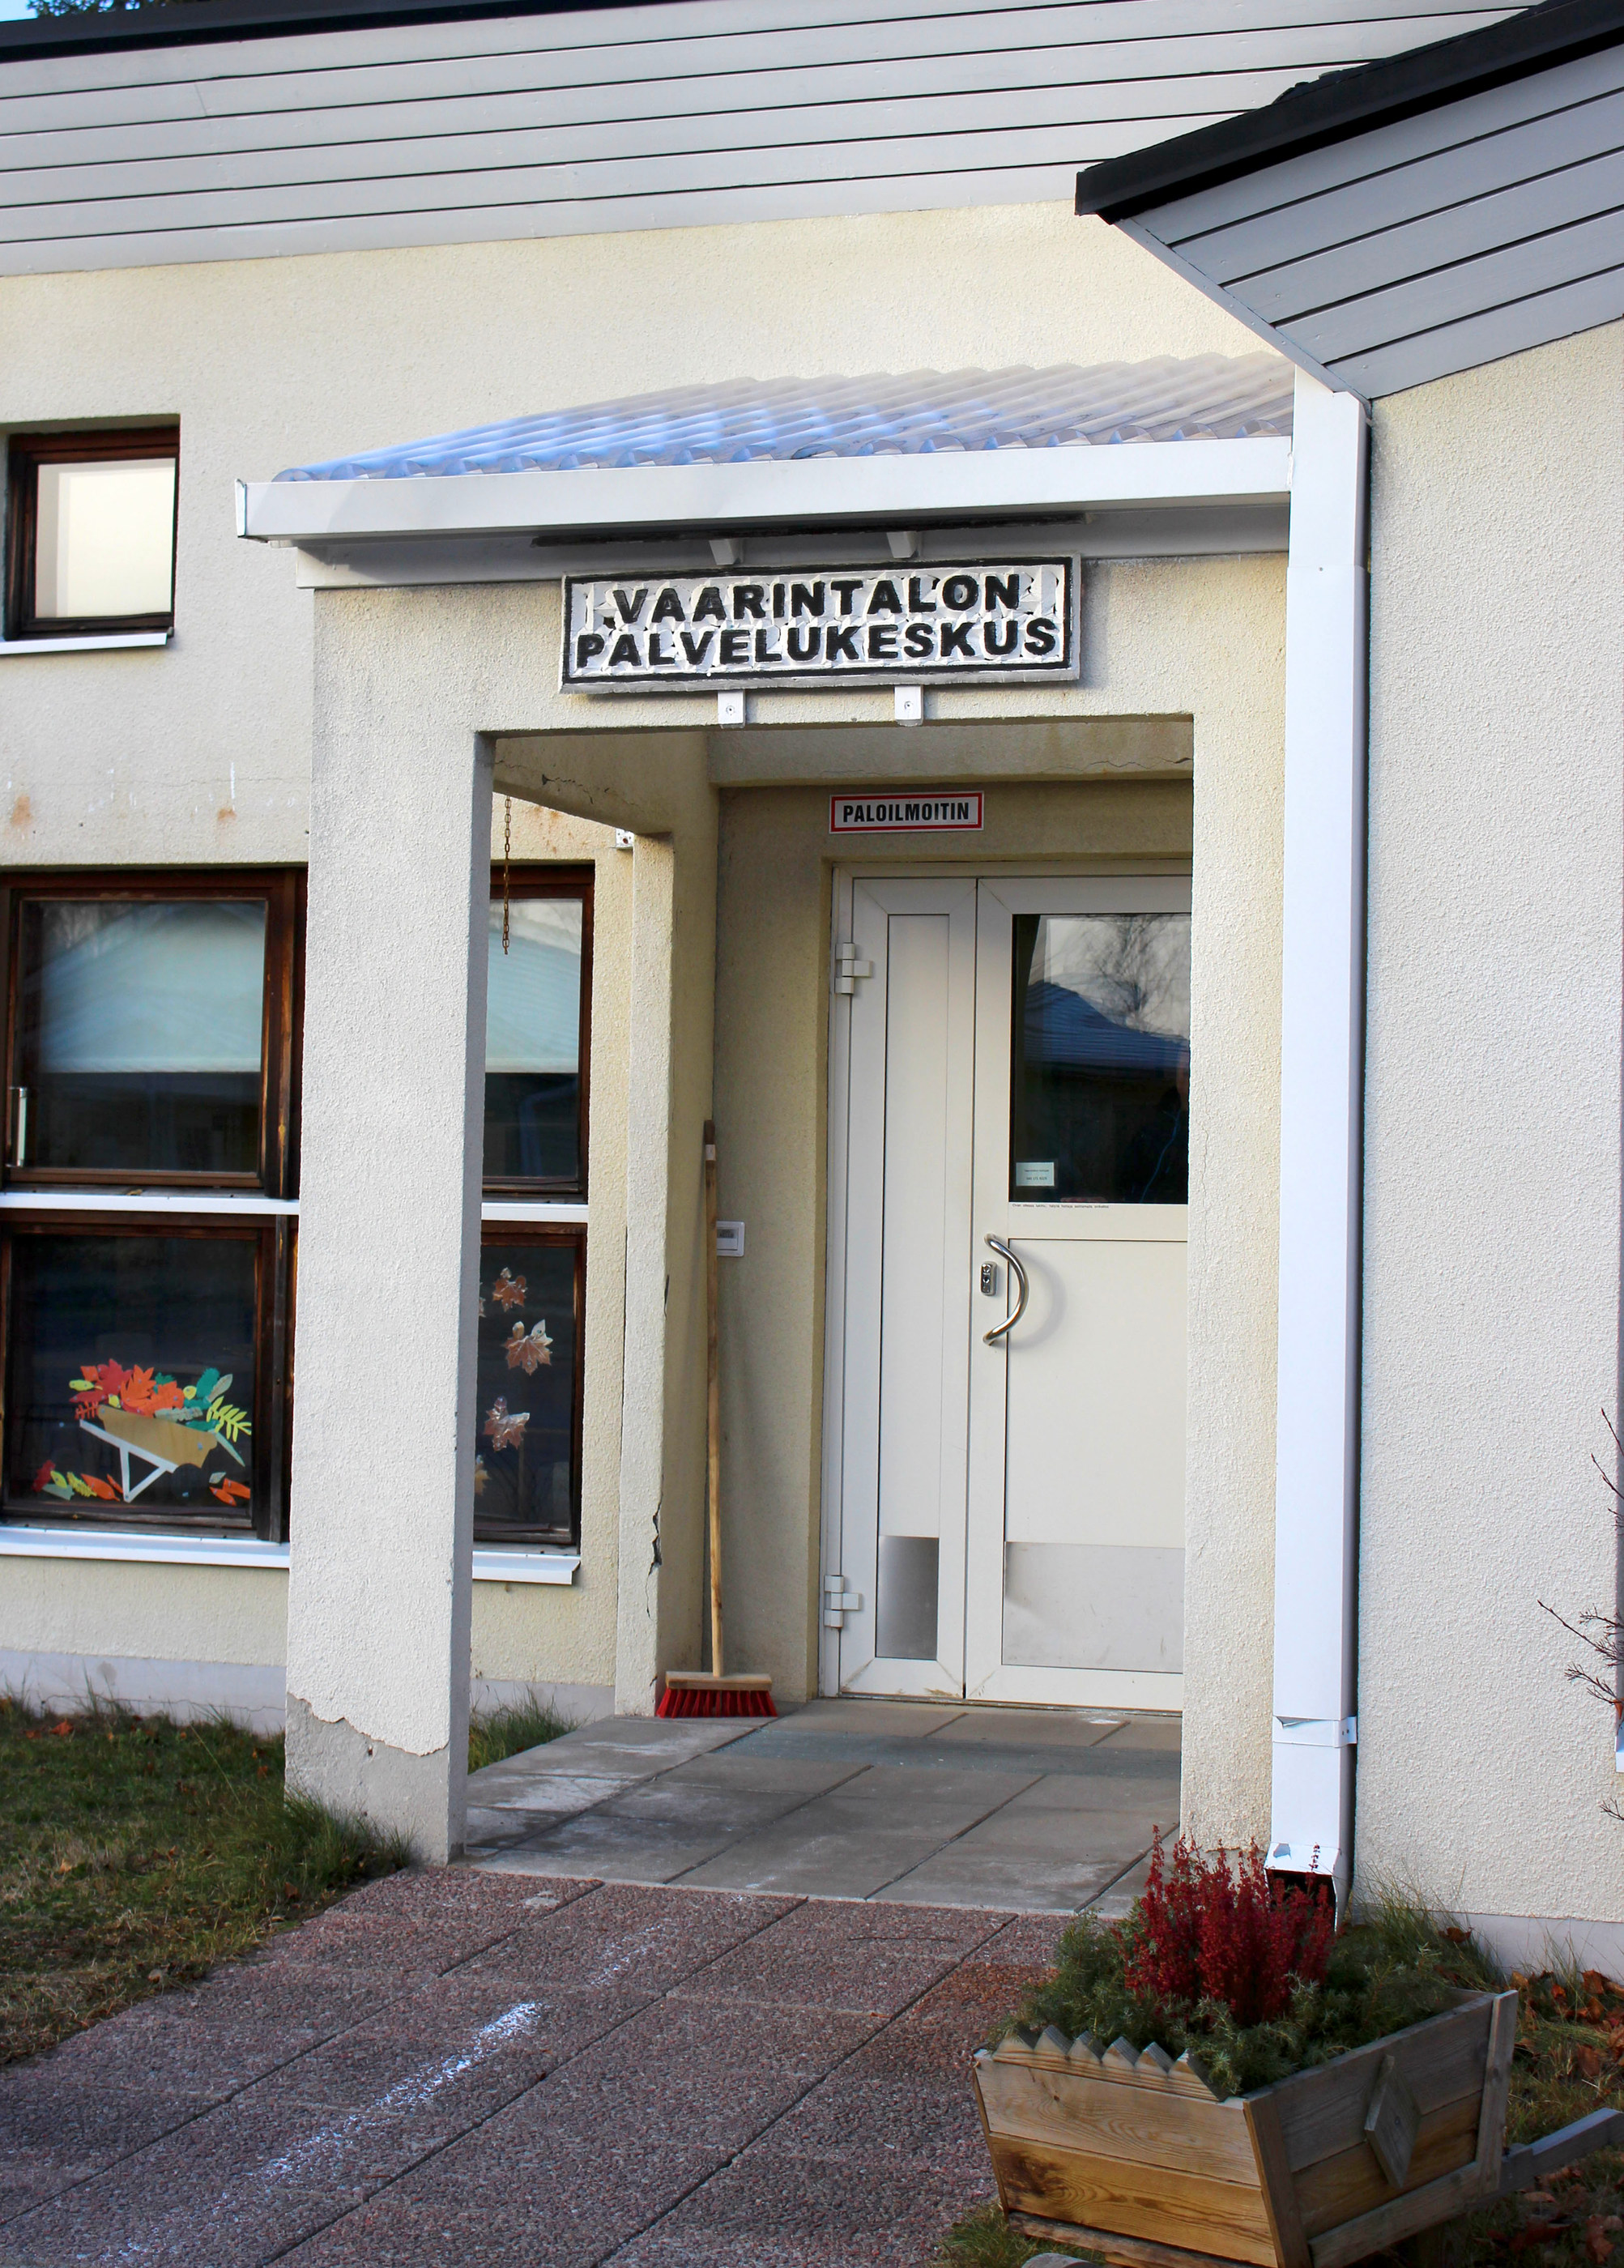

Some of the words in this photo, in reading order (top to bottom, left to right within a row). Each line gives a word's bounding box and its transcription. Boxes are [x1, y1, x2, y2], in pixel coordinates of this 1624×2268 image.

[612, 573, 1021, 624] VAARINTALON
[576, 618, 1057, 667] PALVELUKESKUS
[842, 802, 970, 823] PALOILMOITIN
